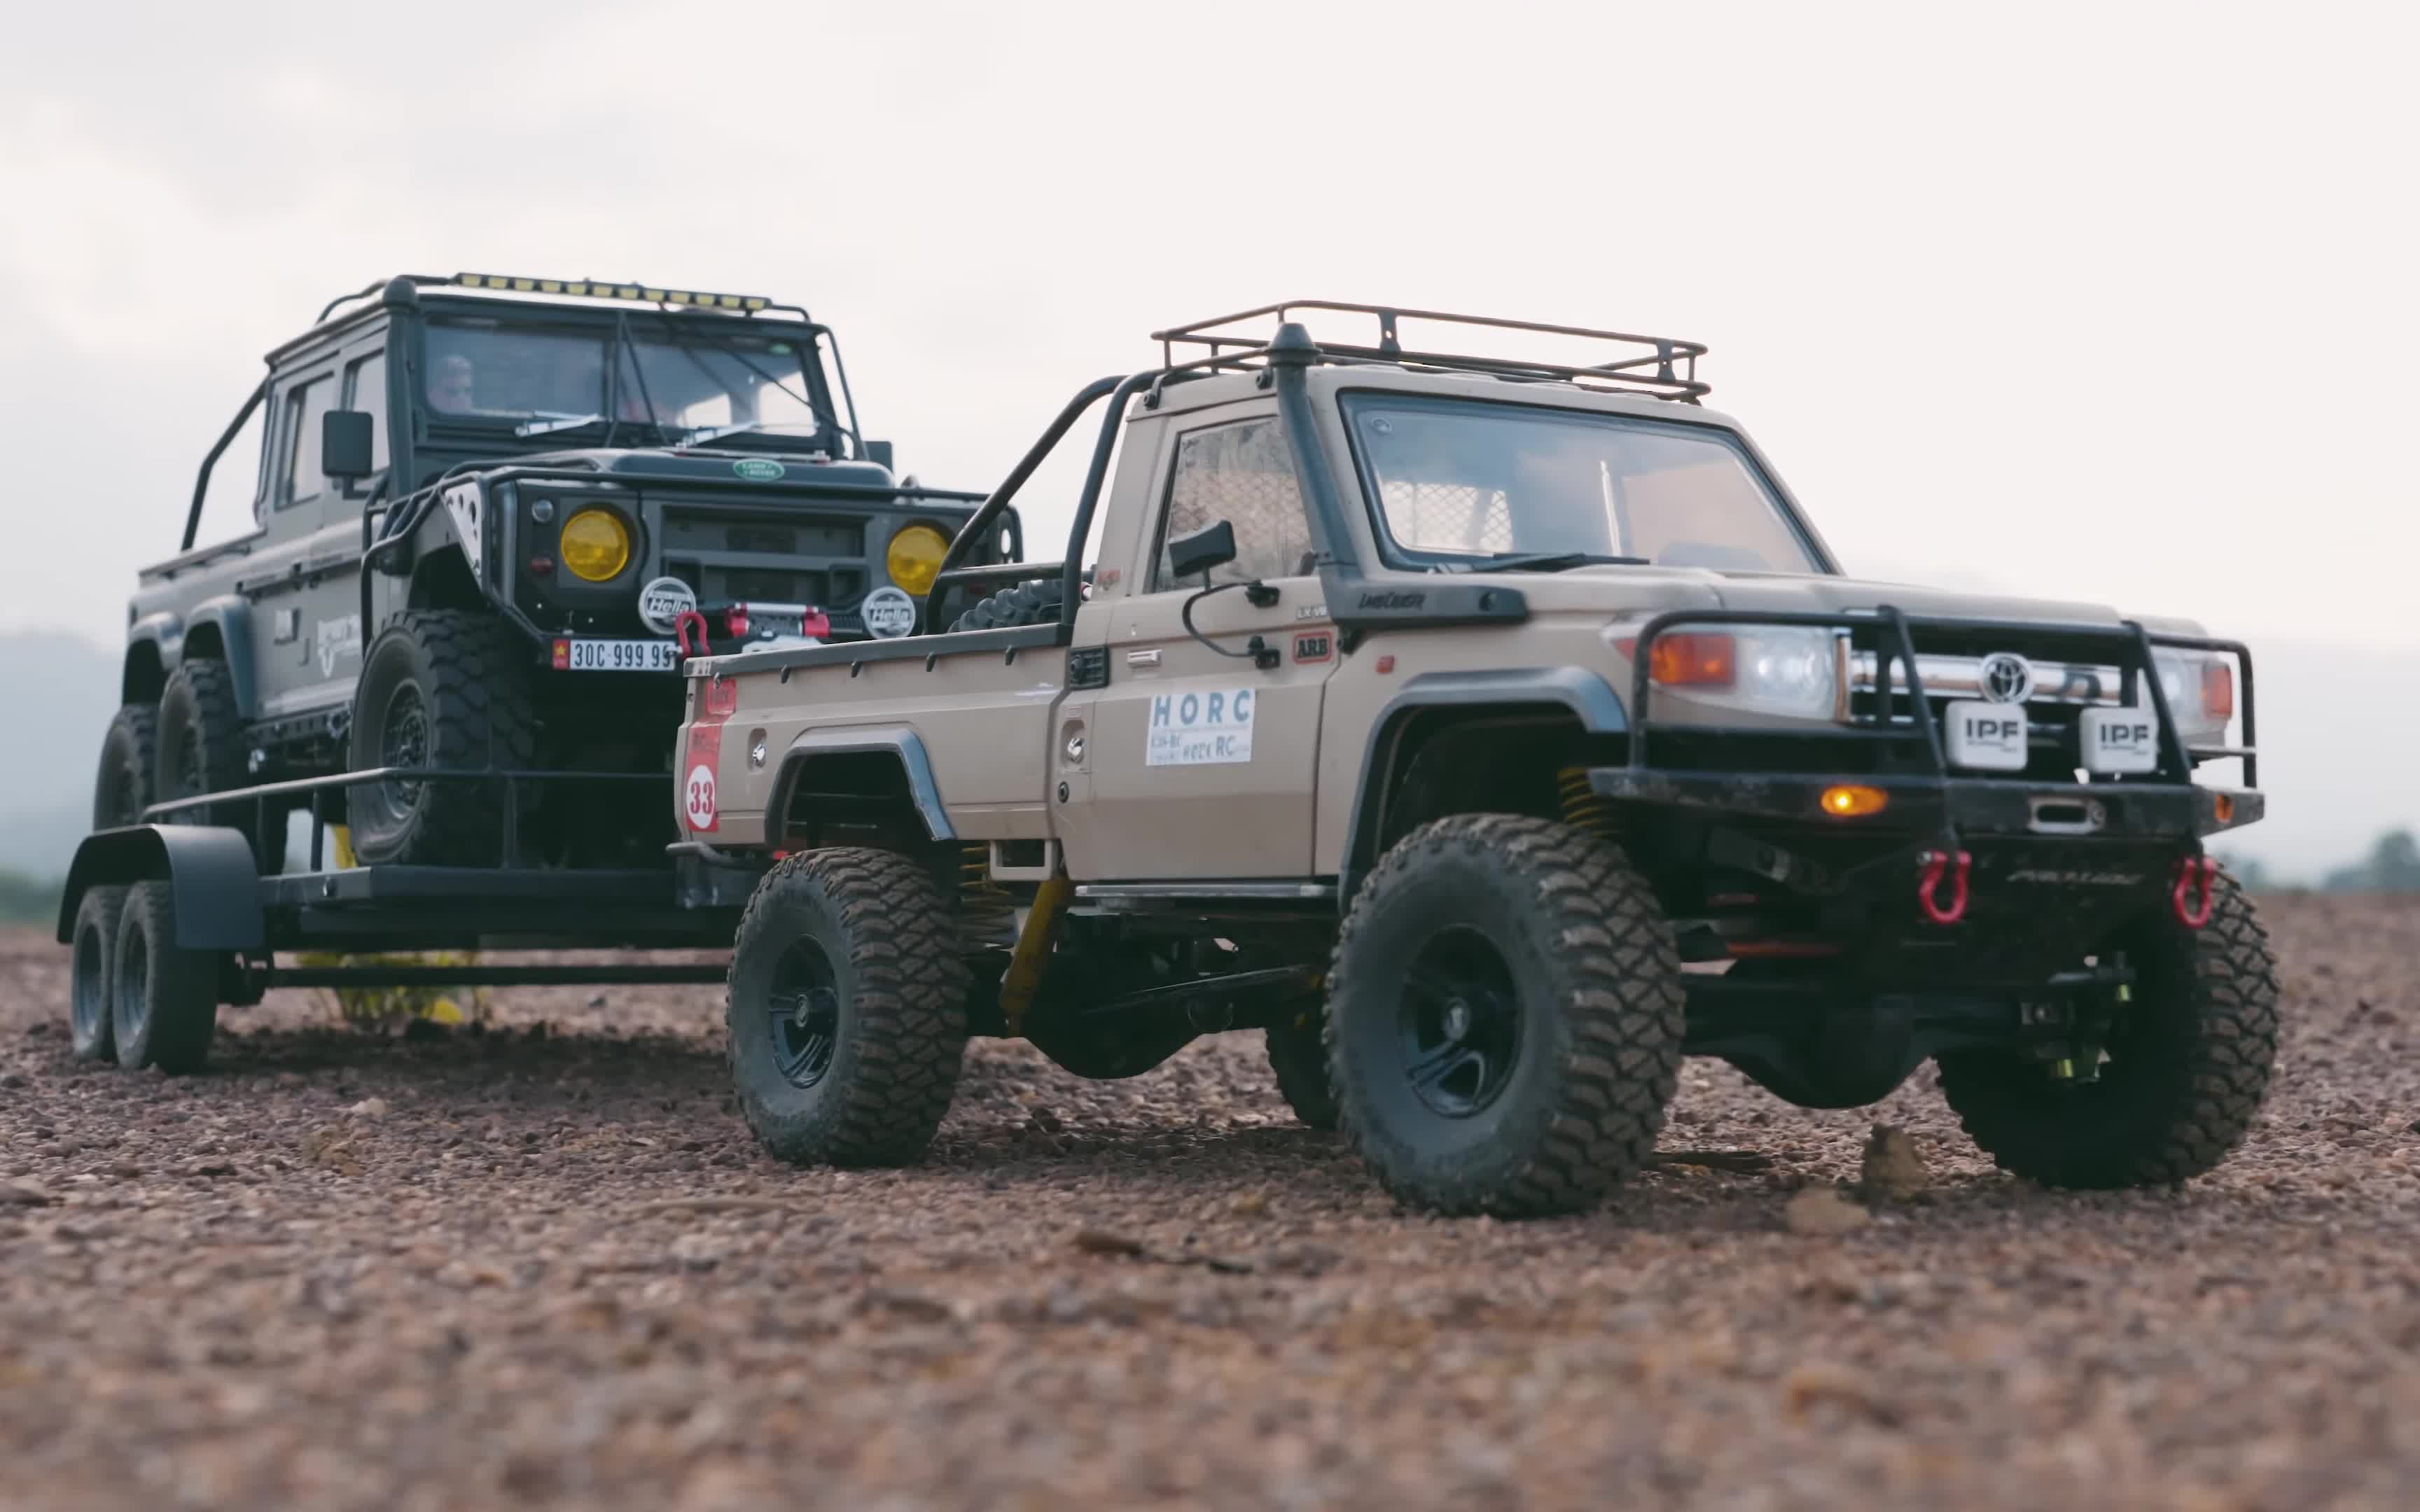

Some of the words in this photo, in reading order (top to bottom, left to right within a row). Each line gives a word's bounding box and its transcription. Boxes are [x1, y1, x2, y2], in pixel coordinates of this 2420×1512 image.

[648, 598, 690, 614] Hella
[872, 608, 908, 624] Hella
[1298, 638, 1328, 658] ARB
[1154, 690, 1251, 727] HORC
[1966, 718, 2019, 738] IPF
[2101, 724, 2149, 743] IPF
[690, 781, 714, 815] 33
